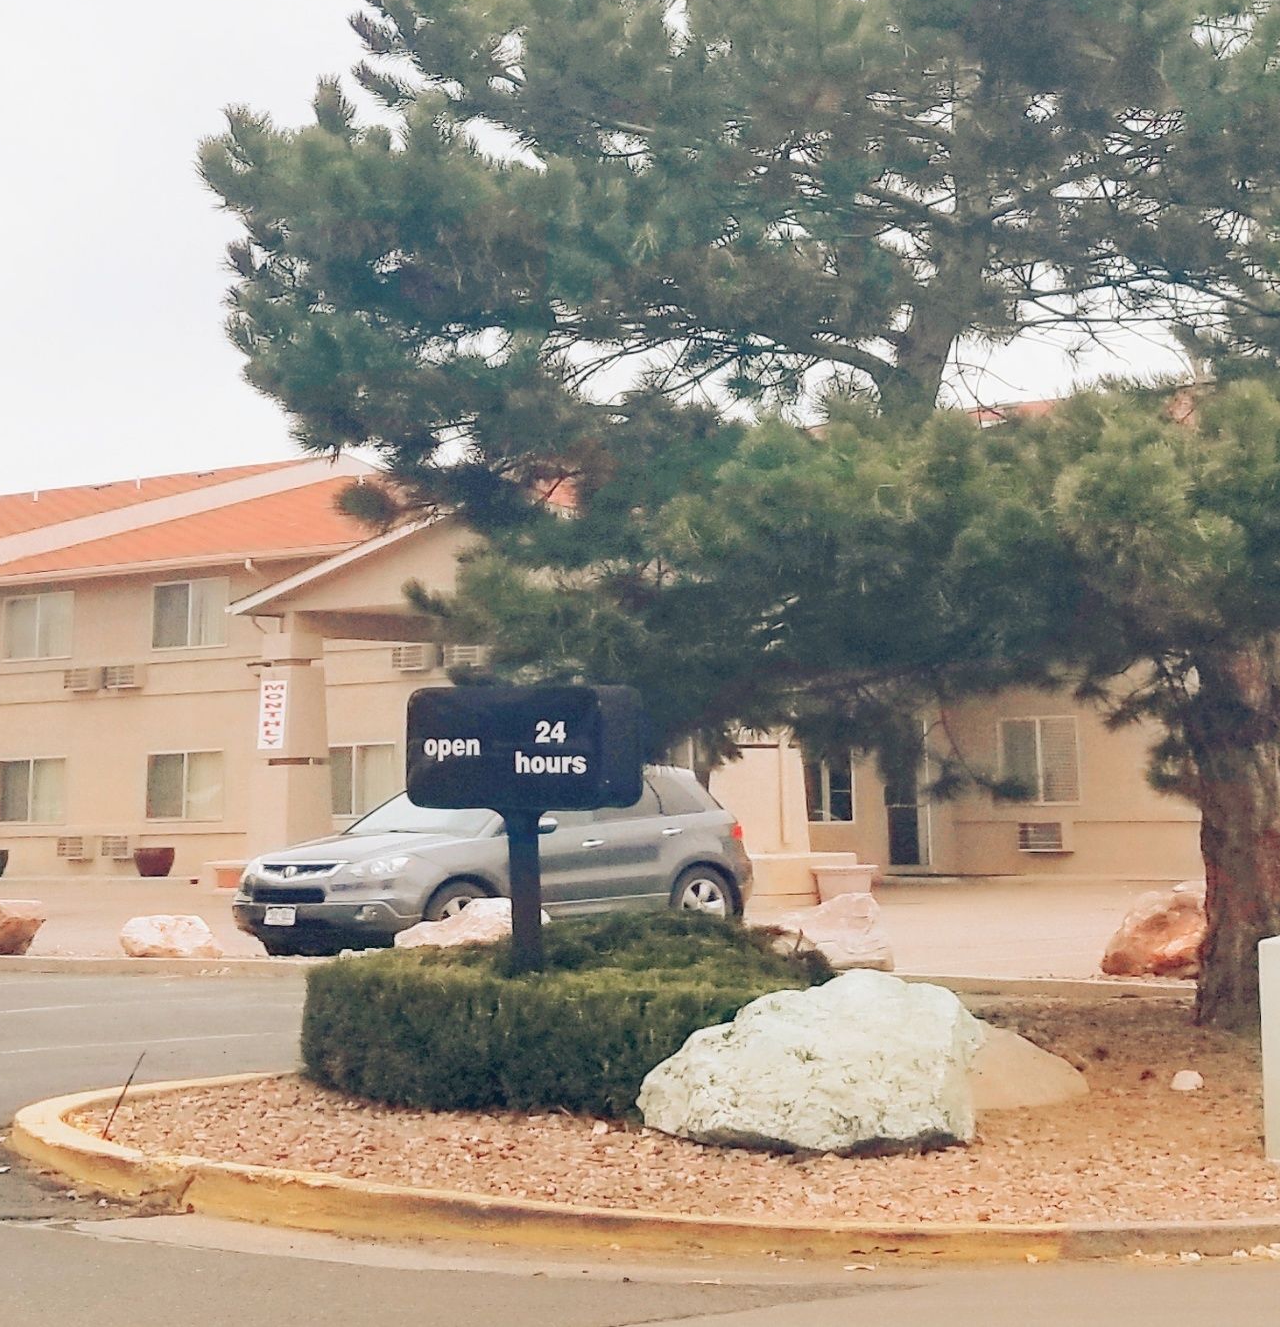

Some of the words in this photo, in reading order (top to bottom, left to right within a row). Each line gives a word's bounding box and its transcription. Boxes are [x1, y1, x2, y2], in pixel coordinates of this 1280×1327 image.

[263, 684, 285, 745] MONTHLY
[535, 721, 566, 744] 24
[424, 738, 480, 761] open
[515, 751, 587, 774] hours
